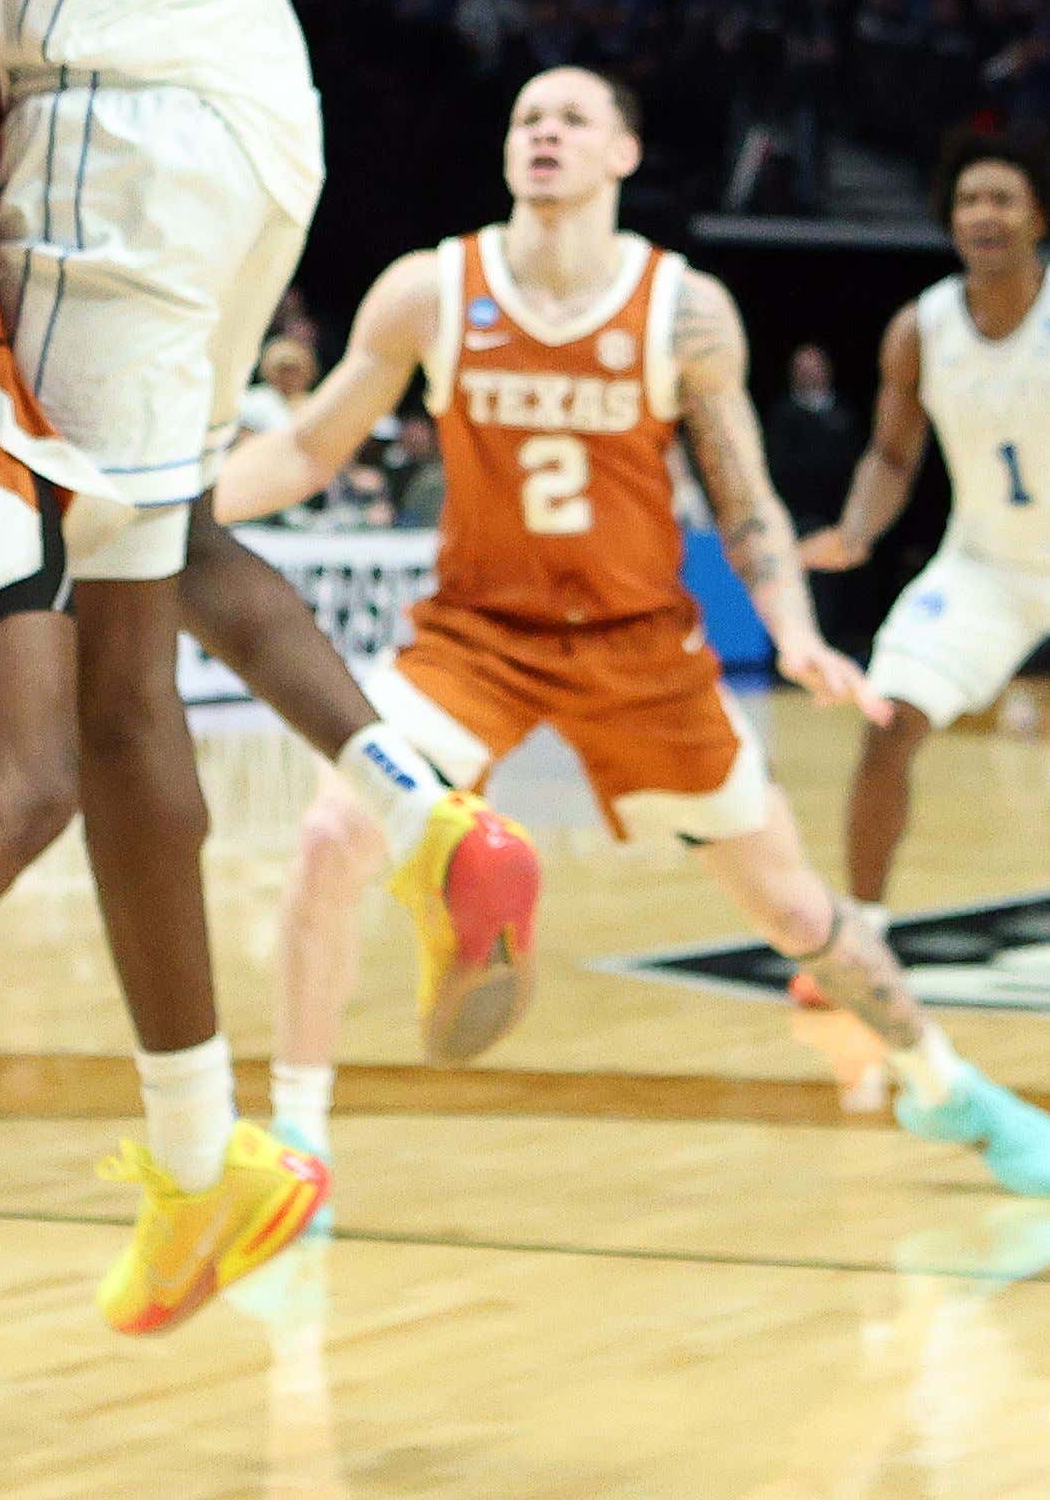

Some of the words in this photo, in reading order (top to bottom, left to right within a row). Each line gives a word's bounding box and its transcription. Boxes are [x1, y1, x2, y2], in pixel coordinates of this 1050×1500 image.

[459, 370, 641, 435] TEXAS
[517, 434, 594, 537] 2
[997, 440, 1033, 507] 1
